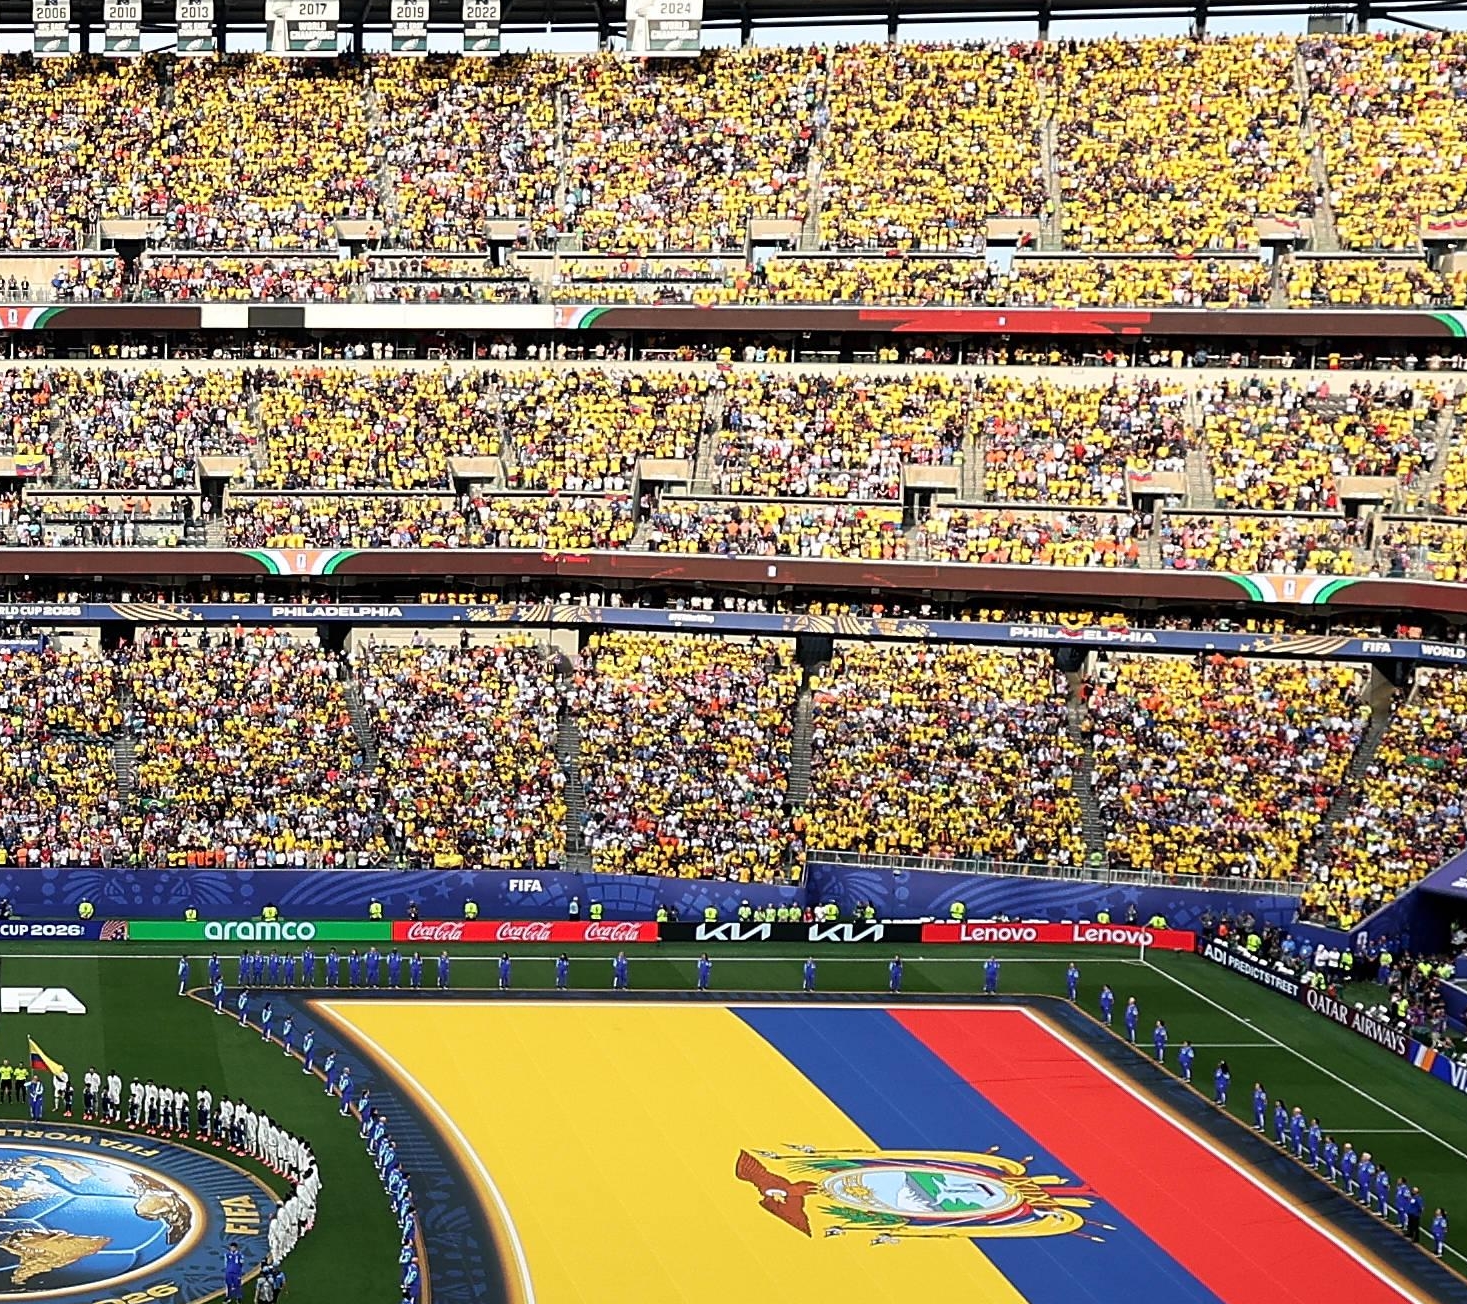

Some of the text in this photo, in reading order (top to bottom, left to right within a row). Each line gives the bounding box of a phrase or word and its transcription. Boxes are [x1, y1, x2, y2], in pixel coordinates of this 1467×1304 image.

[36, 7, 66, 19] 2006
[109, 7, 136, 19] 2010
[181, 6, 209, 19] 2013
[299, 3, 327, 16] 2017
[397, 6, 425, 19] 2019
[467, 6, 497, 19] 2022
[660, 2, 691, 15] 2024
[20, 606, 42, 616] CUP
[43, 606, 81, 617] 2026
[272, 606, 402, 617] PHILADELPHIA
[1363, 641, 1390, 653] FIFA
[1422, 645, 1464, 659] WORLD
[509, 879, 542, 892] FIFA
[0, 924, 28, 936] CUP
[31, 924, 80, 936] 2026
[204, 921, 316, 941] aramco
[960, 925, 1036, 942] Lenovo
[1073, 926, 1153, 946] Lenovo
[1204, 944, 1299, 997] ADI PREDICTSTREET
[1307, 989, 1406, 1054] QATAR AIRWAYS
[223, 1194, 260, 1236] FIFA
